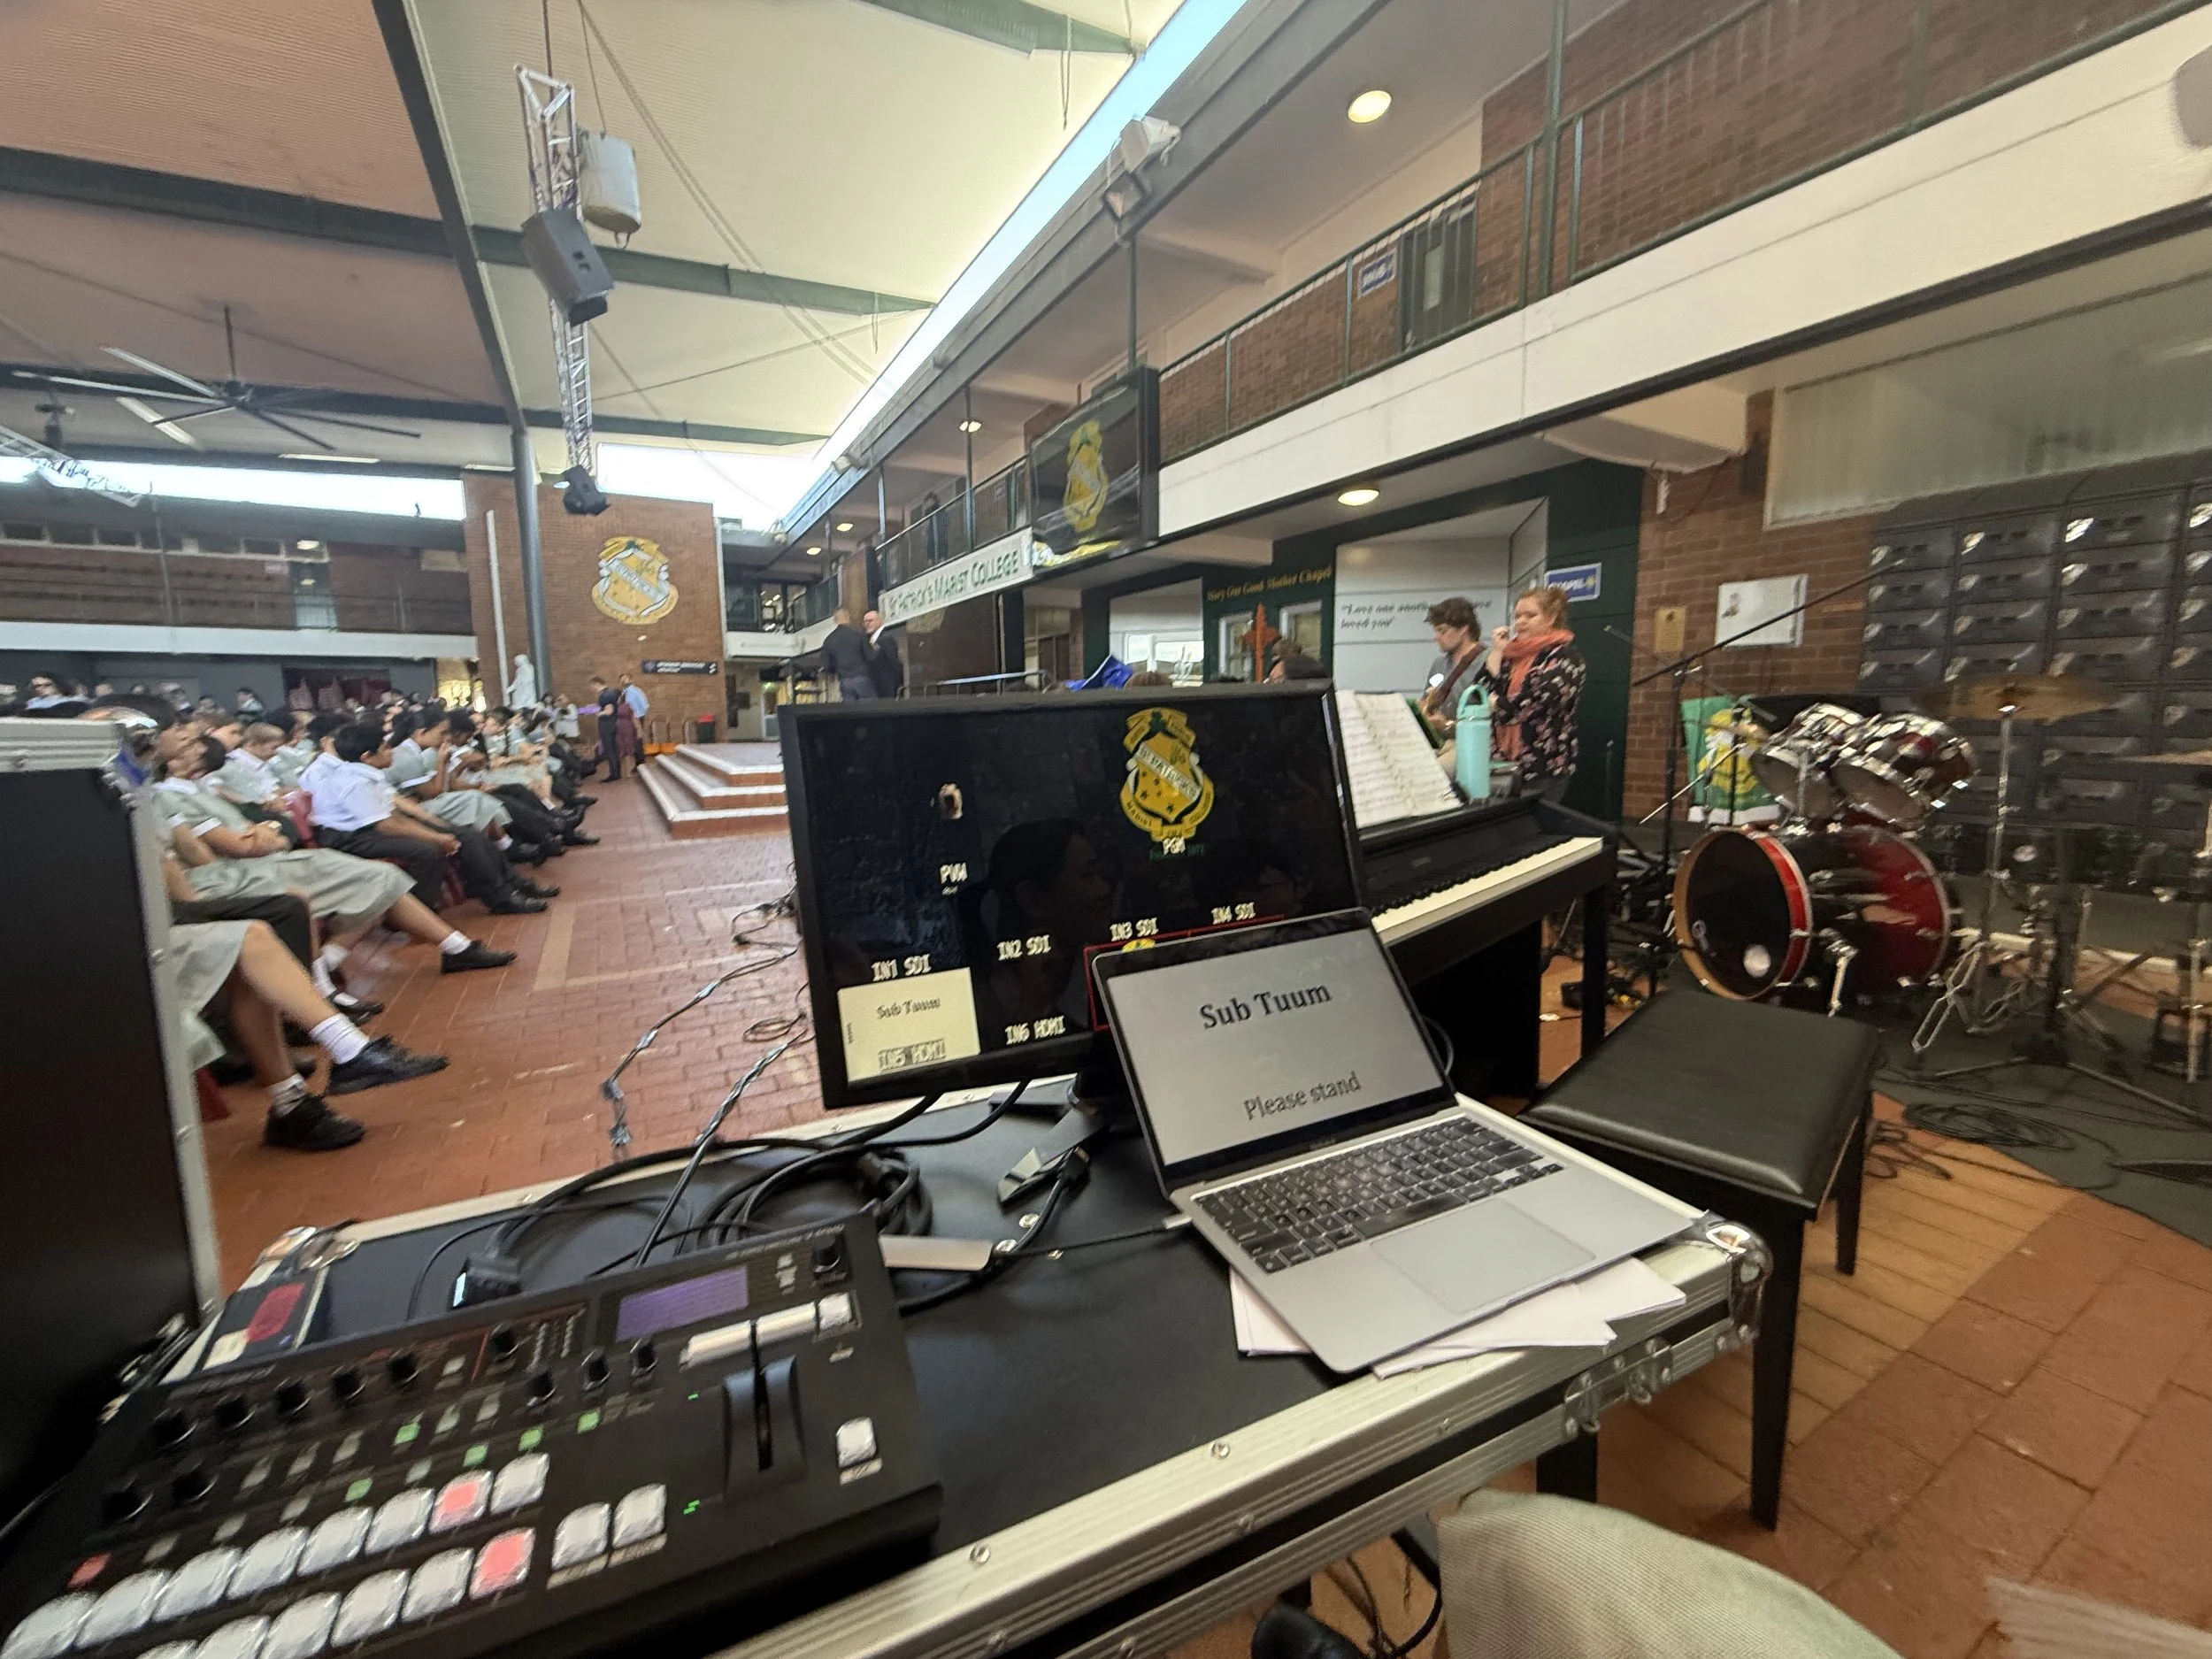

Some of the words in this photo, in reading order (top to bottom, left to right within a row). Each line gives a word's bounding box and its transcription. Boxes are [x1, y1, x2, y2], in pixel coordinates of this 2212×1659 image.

[934, 570, 970, 602] MARIST
[972, 549, 1018, 588] COLLEGE
[1299, 565, 1333, 584] Chapel
[1211, 905, 1233, 926] IN4
[1234, 902, 1256, 921] SDI
[1110, 921, 1133, 941] IN3
[1135, 917, 1159, 938] SDI
[997, 939, 1023, 961] IN2
[1026, 934, 1051, 956] SDI
[871, 958, 898, 982] IN1
[903, 953, 932, 976] SDI
[876, 1002, 902, 1019] Sub
[902, 998, 941, 1016] Tuum
[1199, 997, 1252, 1030] Sub
[1253, 983, 1333, 1018] Tuum
[1004, 1022, 1030, 1045] IN6
[1033, 1015, 1066, 1040] HDMI
[878, 1047, 906, 1071] IN5
[910, 1038, 947, 1064] HDMI
[1243, 1088, 1307, 1120] Please
[1310, 1071, 1362, 1103] stand
